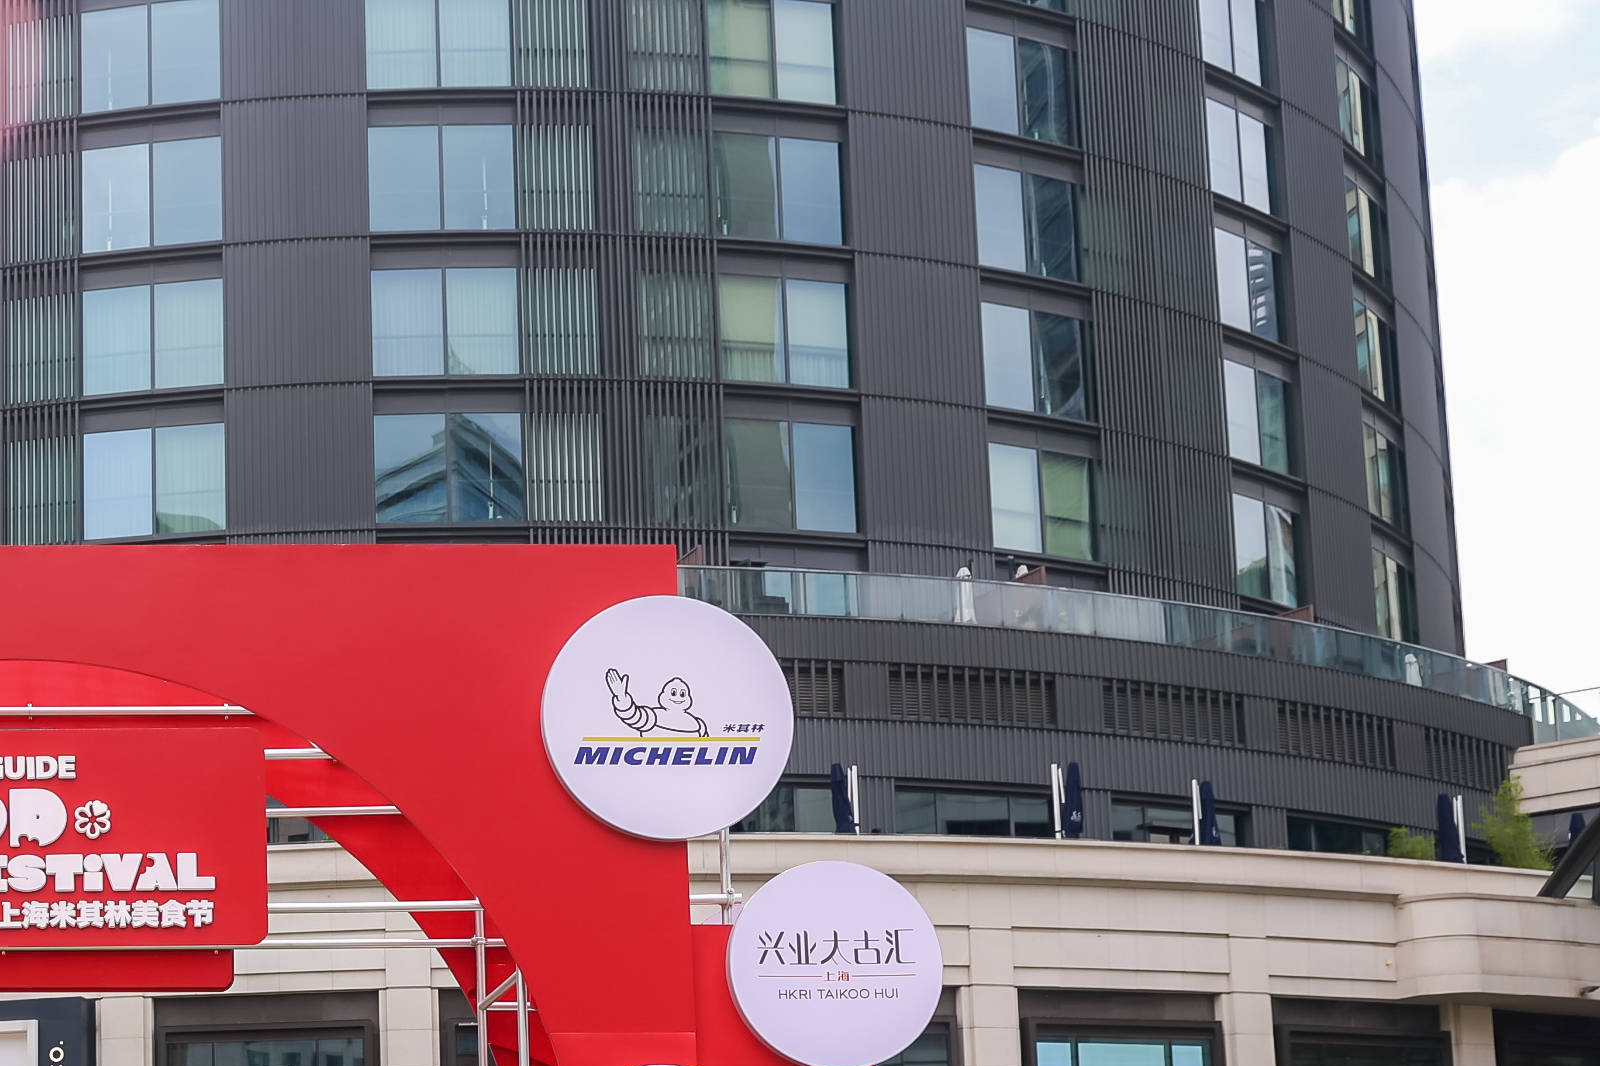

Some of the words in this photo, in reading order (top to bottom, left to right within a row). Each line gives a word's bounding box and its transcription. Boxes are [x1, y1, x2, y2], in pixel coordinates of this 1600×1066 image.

[723, 723, 766, 734] 米其林
[574, 747, 758, 766] MICHELIN
[757, 928, 917, 965] 兴业太古汇
[823, 970, 851, 982] 上海
[778, 989, 812, 1000] HKRI
[817, 988, 870, 1000] TAIKOO
[874, 987, 899, 999] HUI
